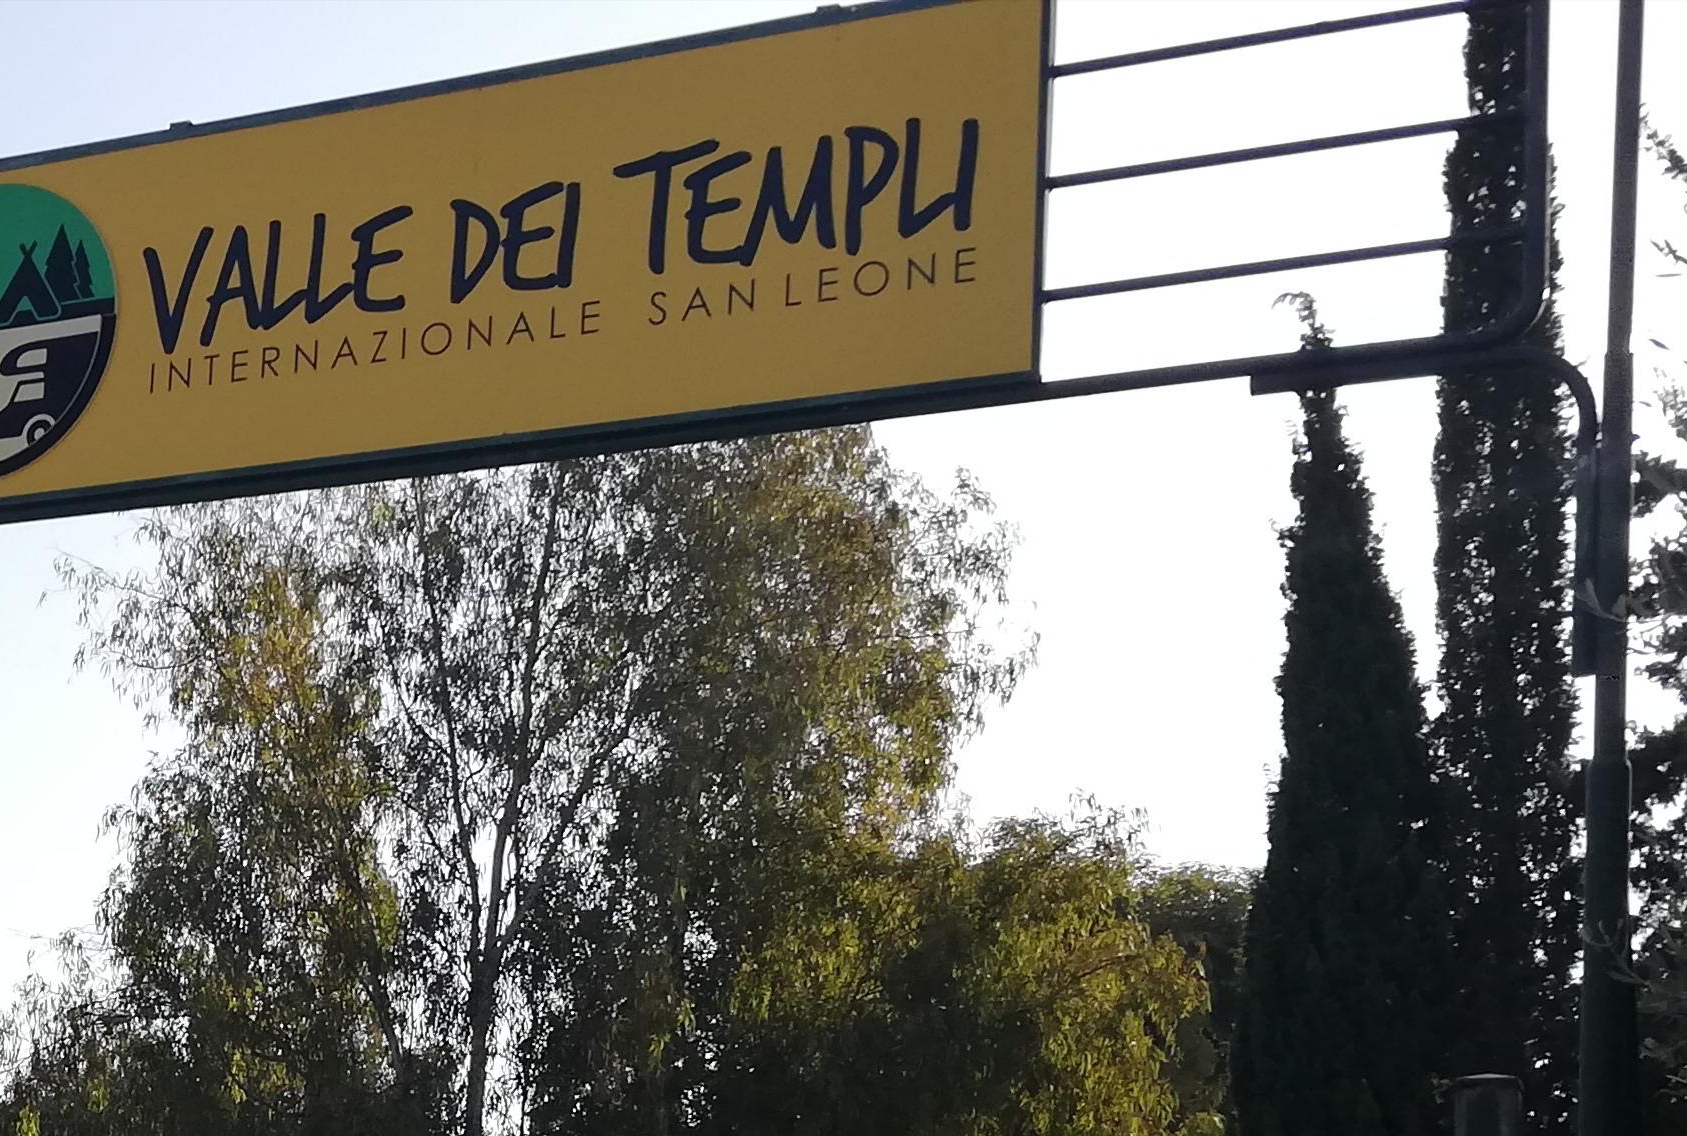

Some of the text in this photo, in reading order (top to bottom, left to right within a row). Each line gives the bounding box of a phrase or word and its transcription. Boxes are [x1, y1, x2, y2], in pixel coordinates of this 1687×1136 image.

[143, 118, 979, 354] VALLE DEI TEMPLI
[148, 248, 978, 394] INTERNAZIONALE SAN LEONE
